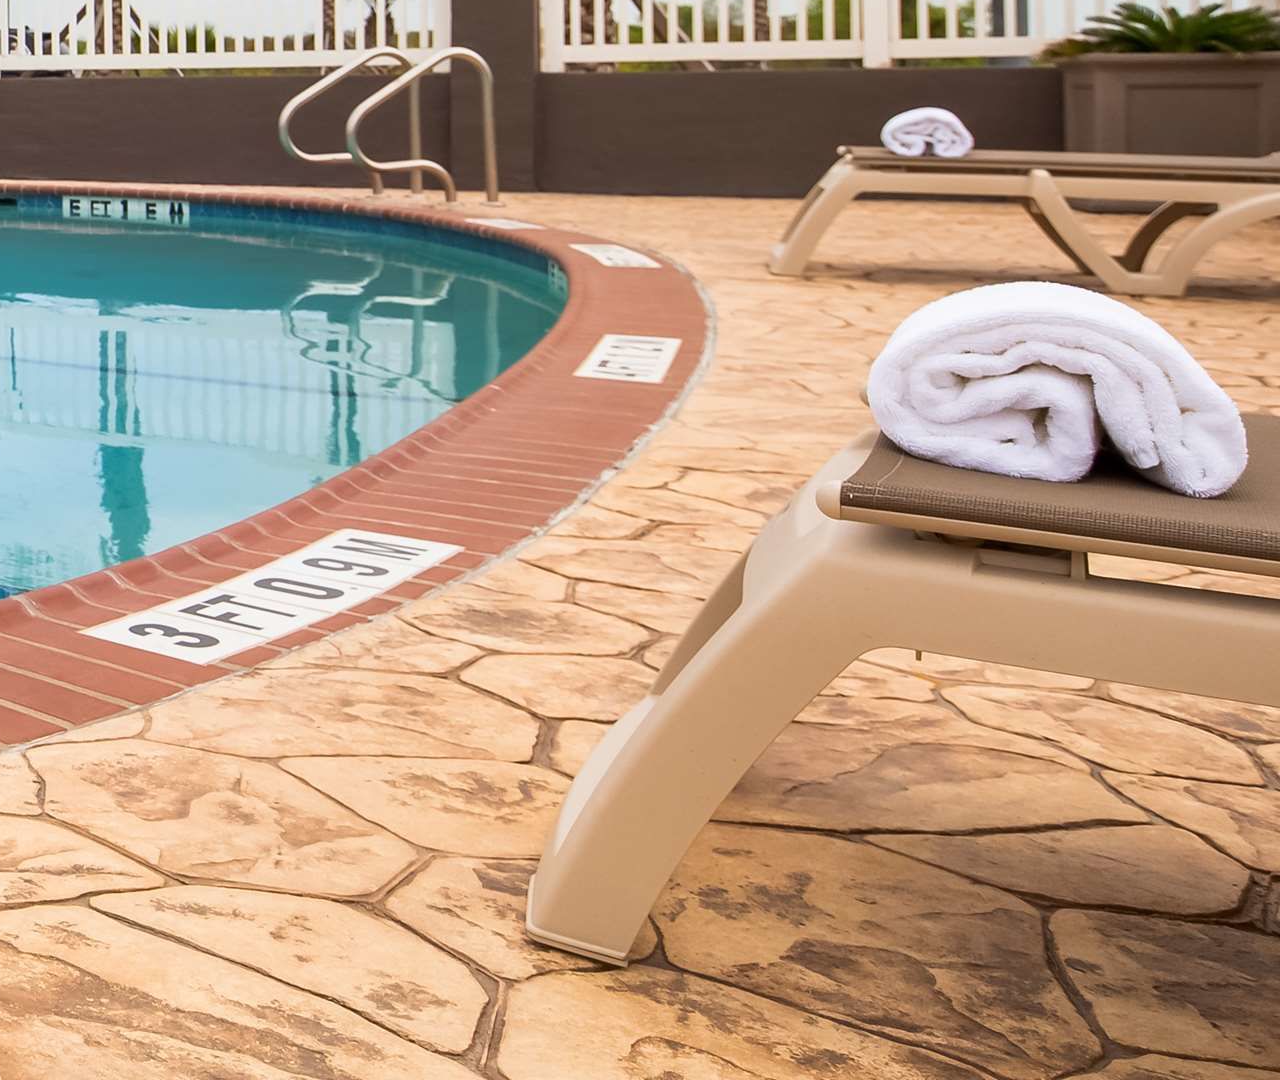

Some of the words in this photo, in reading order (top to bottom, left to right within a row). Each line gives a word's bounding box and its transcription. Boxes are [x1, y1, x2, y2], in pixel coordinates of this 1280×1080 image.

[128, 622, 221, 649] 3
[177, 593, 297, 631] FT
[332, 537, 430, 562] M
